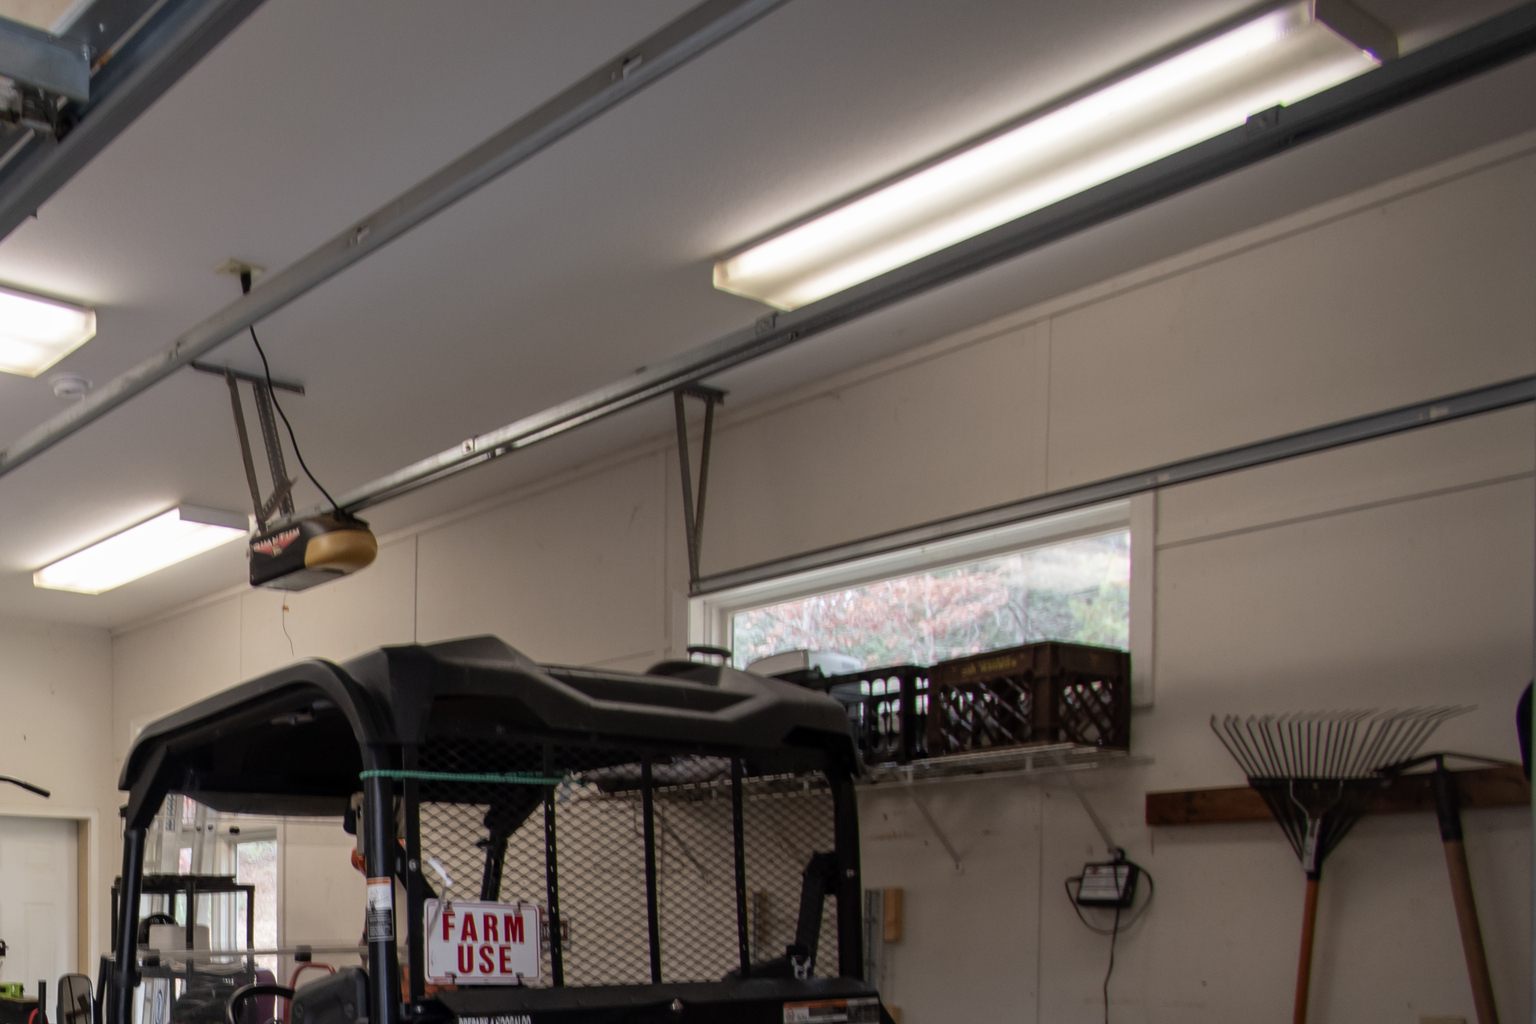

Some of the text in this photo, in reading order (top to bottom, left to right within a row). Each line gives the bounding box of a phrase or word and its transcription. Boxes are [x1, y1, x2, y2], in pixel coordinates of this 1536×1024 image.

[253, 527, 301, 553] QUANTUM
[442, 911, 525, 944] FARM
[457, 943, 513, 975] USE
